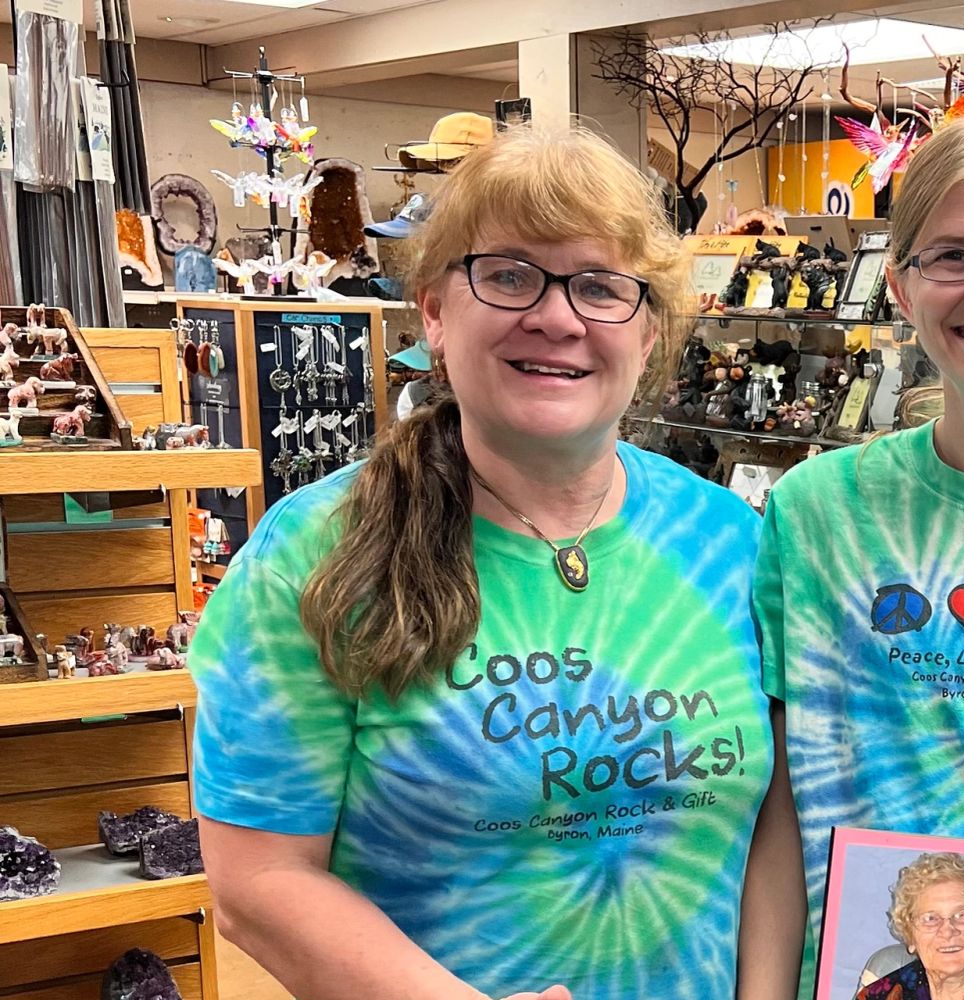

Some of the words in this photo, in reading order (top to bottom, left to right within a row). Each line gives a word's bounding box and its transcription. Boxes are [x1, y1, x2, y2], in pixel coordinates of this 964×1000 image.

[446, 643, 593, 691] Coos
[888, 647, 950, 668] Peace,
[912, 671, 937, 682] Coos
[482, 689, 719, 743] Canyon
[541, 725, 746, 800] Rocks!
[474, 818, 521, 832] Coos
[529, 810, 597, 829] Canyon
[605, 800, 655, 819] Rock
[662, 797, 676, 810] &
[682, 791, 717, 809] Gift
[597, 823, 644, 838] Maine
